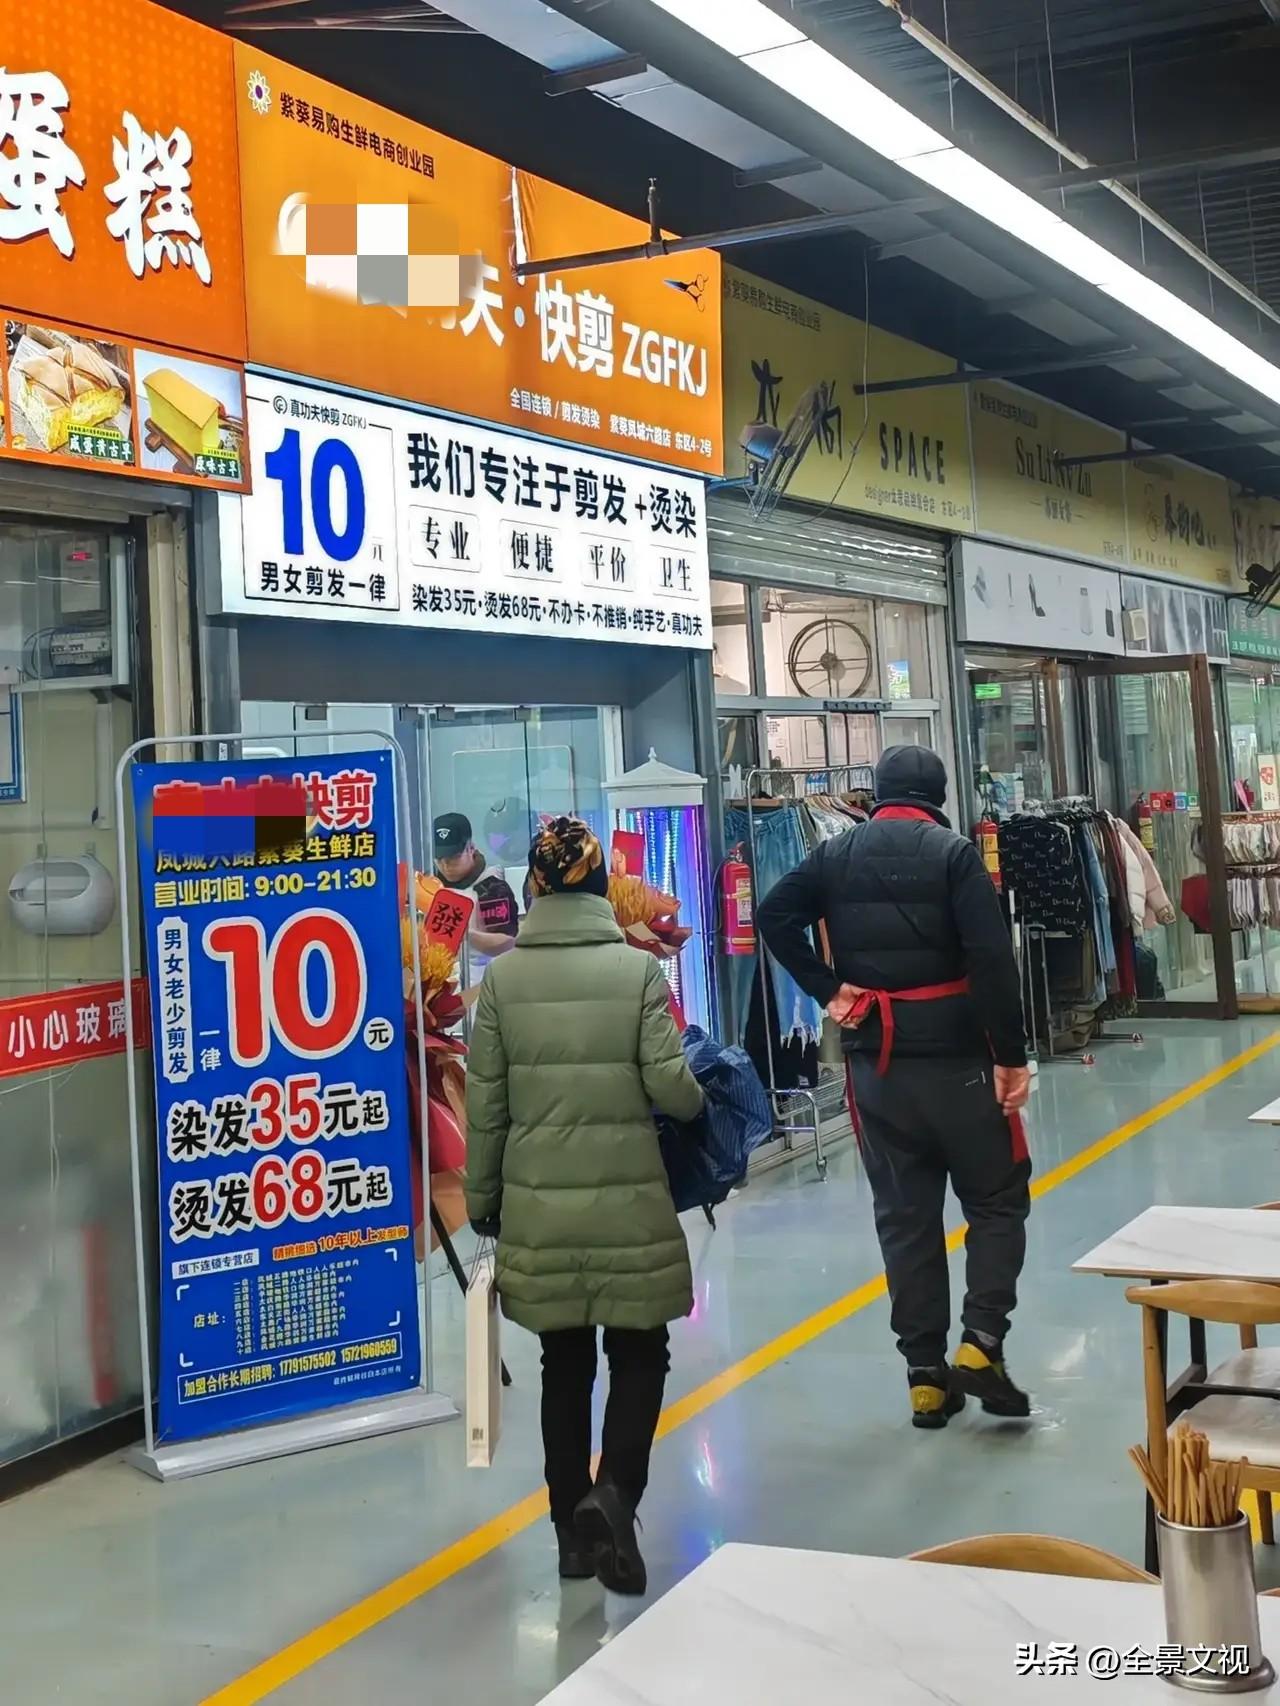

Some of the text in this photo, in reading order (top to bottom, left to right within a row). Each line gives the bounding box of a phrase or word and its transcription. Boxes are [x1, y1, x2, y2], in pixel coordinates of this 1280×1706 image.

[280, 92, 435, 178] 紫葵易购生鲜电商创业园
[0, 66, 212, 286] 蛋糕
[621, 322, 708, 398] ZGFKJ
[290, 399, 367, 430] 真功夫快剪 ZGFKJ
[510, 387, 552, 418] 全国连锁
[195, 455, 239, 477] 原味古早
[407, 432, 697, 539] 我们专注于剪发+烫染
[878, 421, 945, 485] SPACE
[265, 428, 365, 561] 10
[260, 561, 386, 601] 男女剪发一律
[421, 517, 693, 593] 专业 便捷 平价 卫生
[163, 929, 222, 1075] 男女老少剪发 一律
[206, 912, 390, 1064] 10 元
[170, 1077, 386, 1157] 染发35元起
[172, 1152, 389, 1238] 烫发68元起
[178, 1253, 254, 1276] 旗下连锁专营店
[184, 1364, 276, 1398] 加盟合作长期招聘:
[279, 1350, 336, 1376] 17791575502
